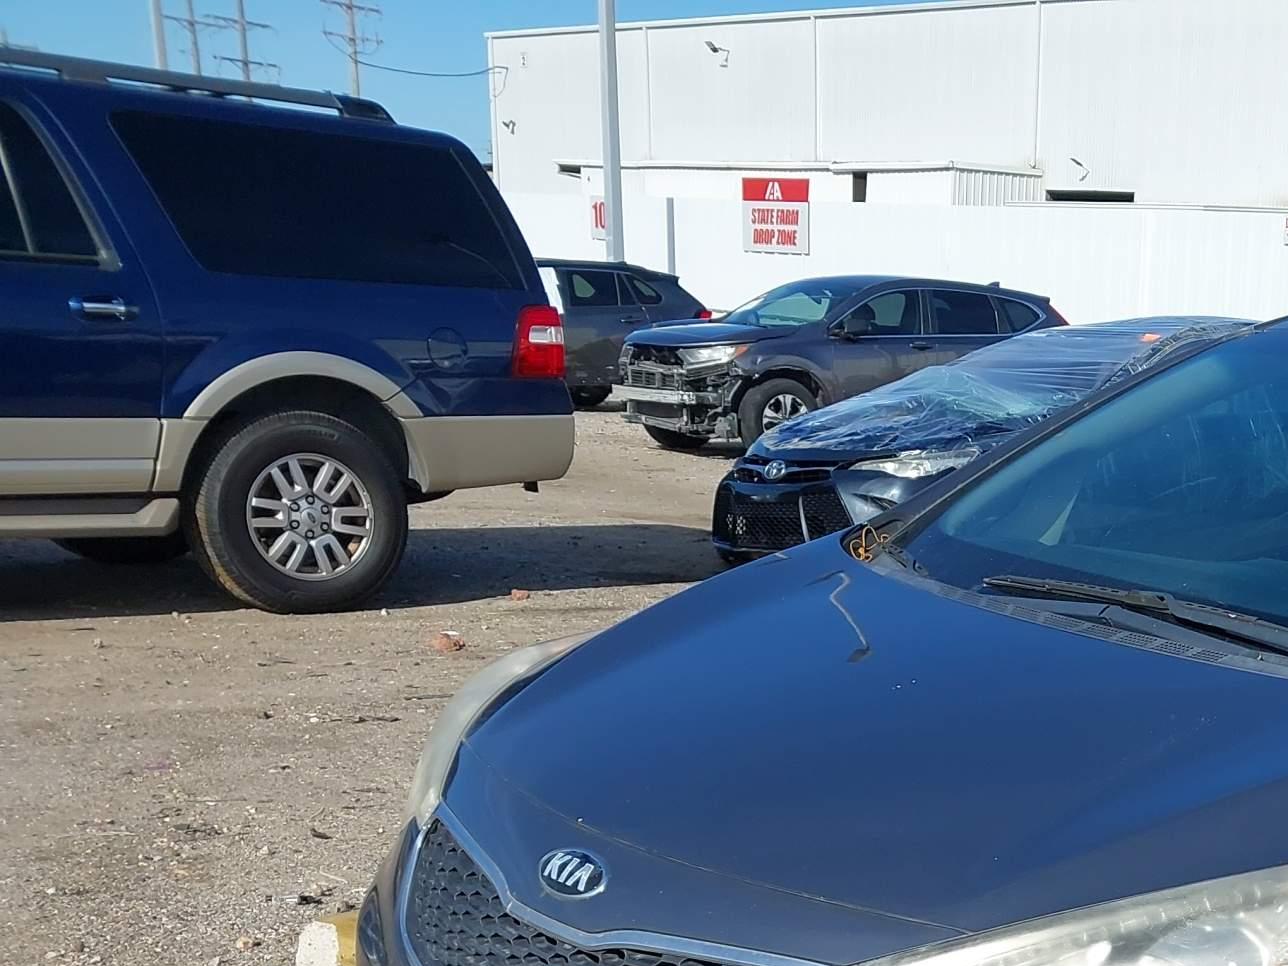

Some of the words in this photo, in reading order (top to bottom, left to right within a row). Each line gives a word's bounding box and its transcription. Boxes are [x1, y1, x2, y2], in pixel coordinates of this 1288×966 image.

[751, 208, 775, 225] STATE
[776, 208, 799, 227] FARM
[753, 228, 775, 246] DROP
[776, 229, 797, 247] ZONE
[542, 852, 594, 892] KIA
